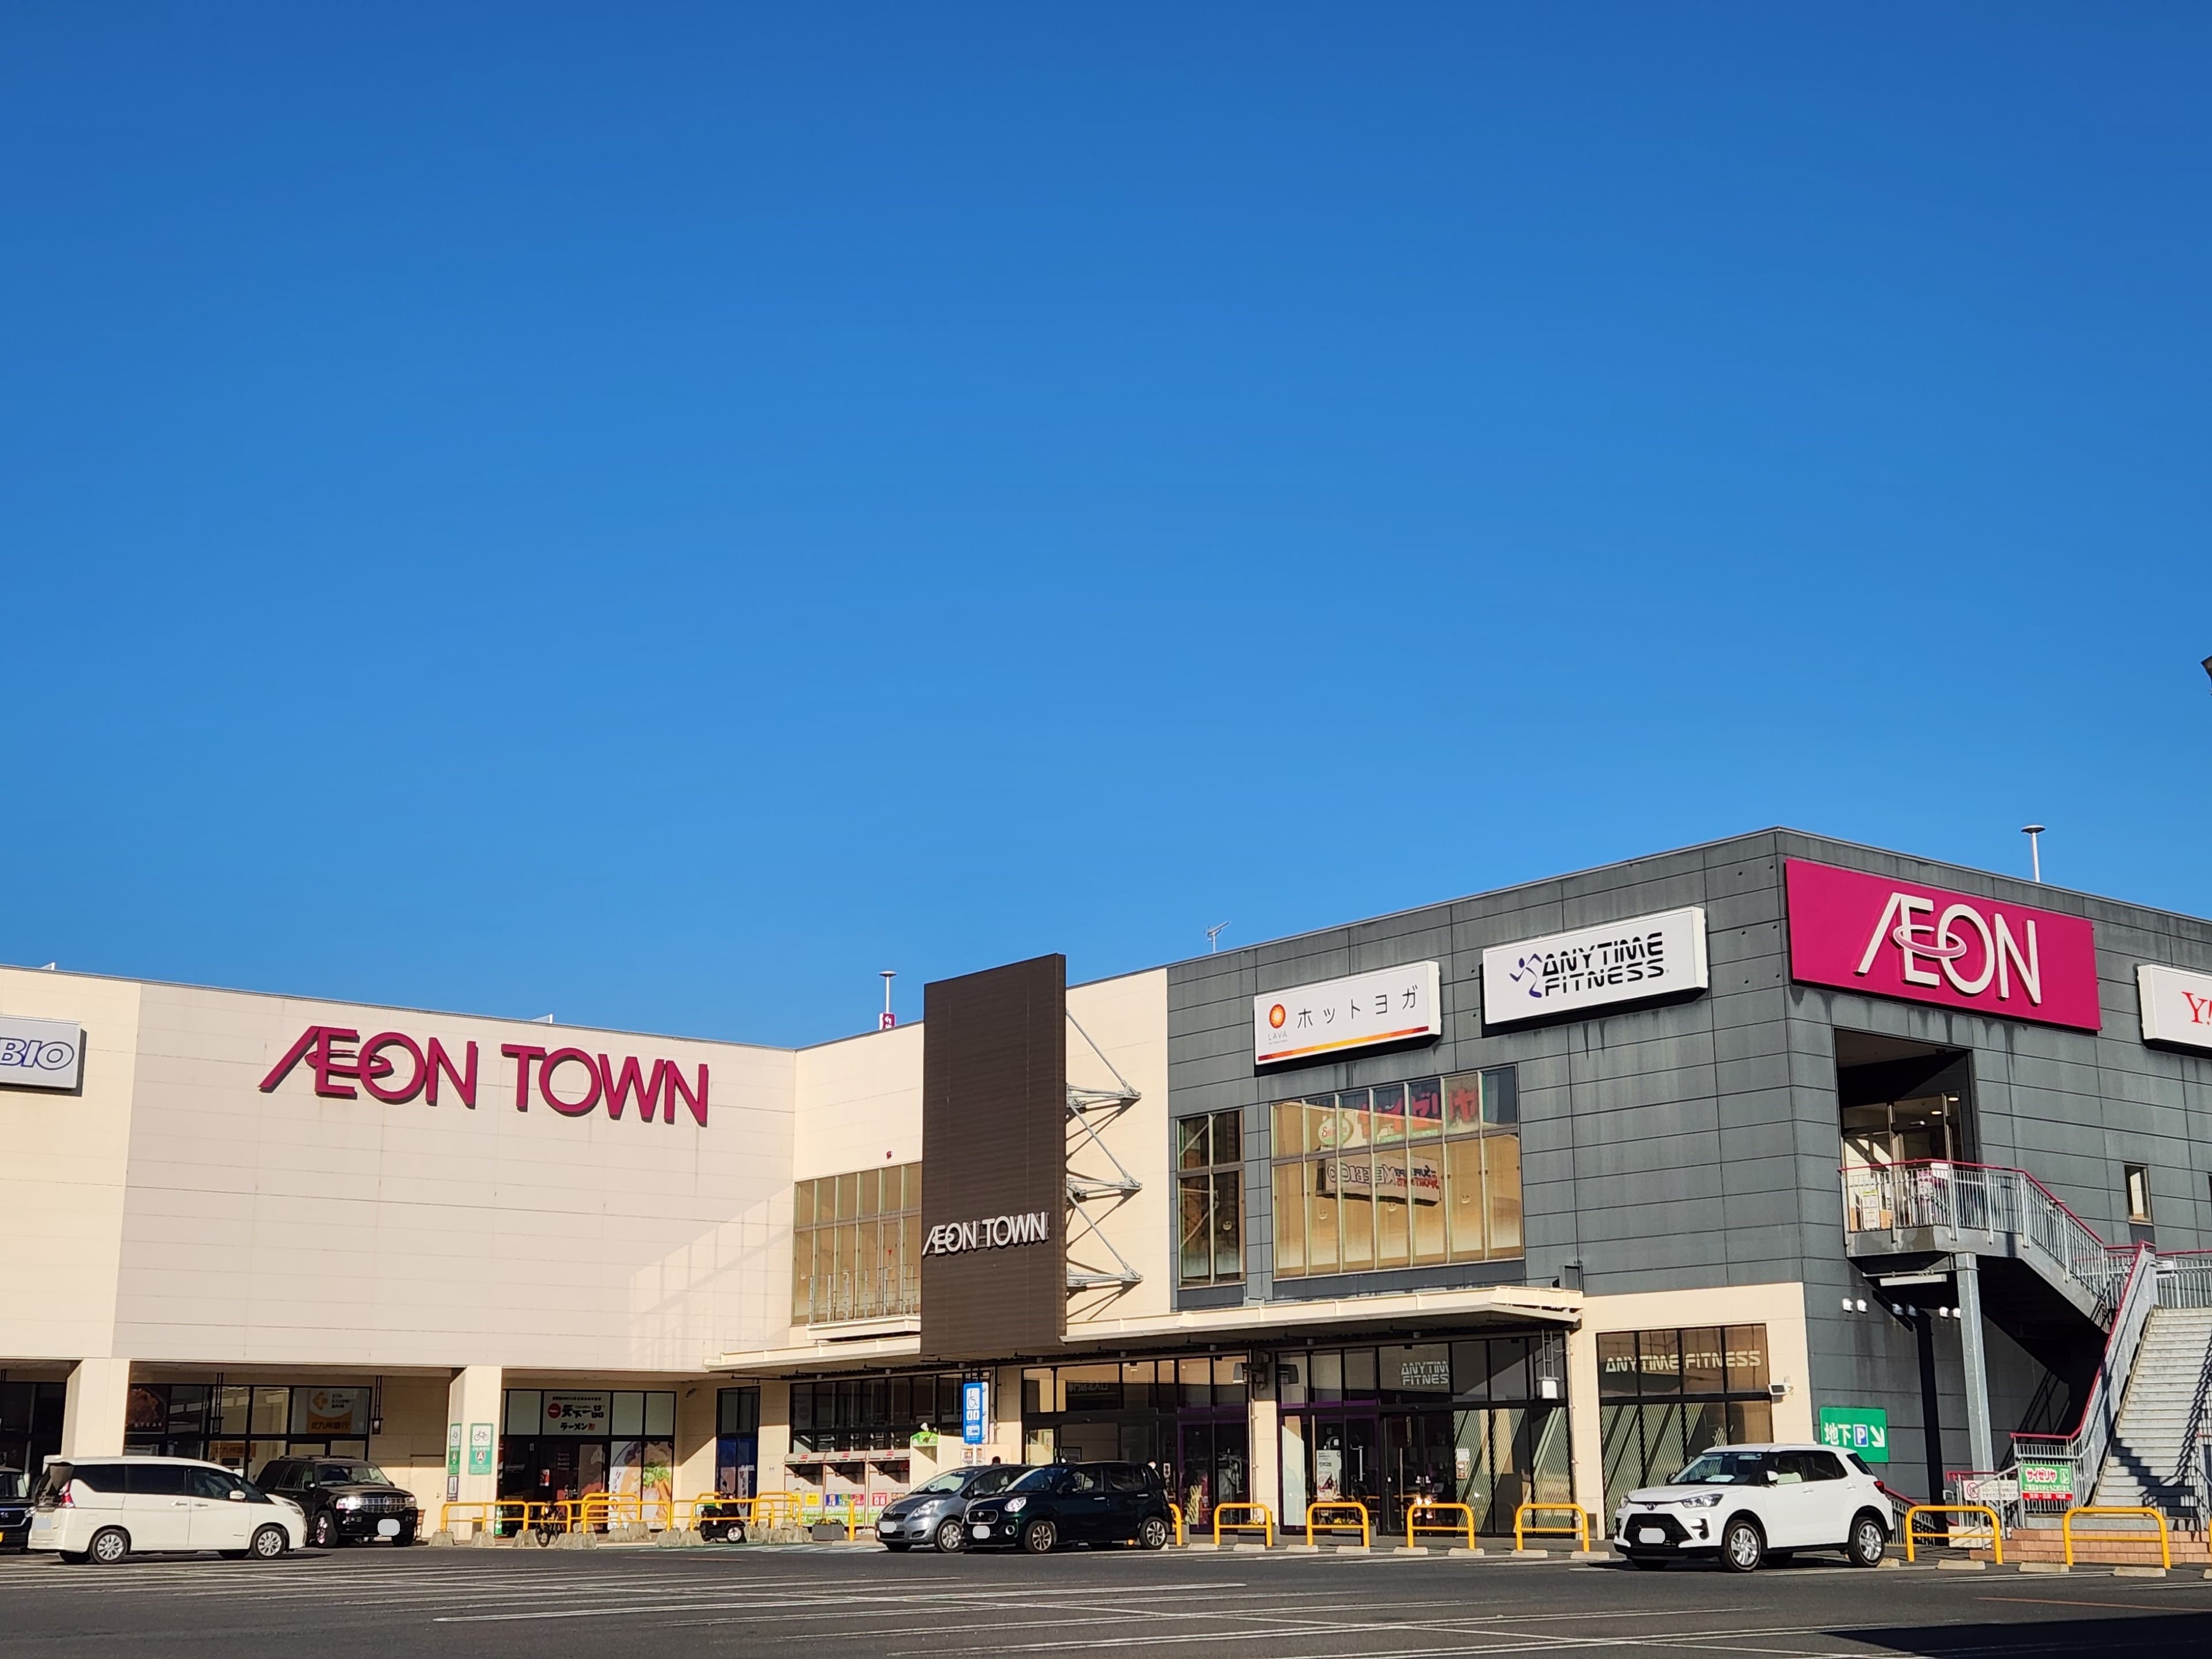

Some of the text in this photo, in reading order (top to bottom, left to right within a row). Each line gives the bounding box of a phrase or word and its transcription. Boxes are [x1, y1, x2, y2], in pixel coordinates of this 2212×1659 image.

[1542, 932, 1663, 977] ANYTIME
[1545, 957, 1664, 997] FITNESS
[1297, 984, 1418, 1029] ホットヨガ
[501, 1043, 709, 1126] TOWN
[982, 1211, 1046, 1247] TOWN
[1605, 1350, 1762, 1373] ANYTIME FITNESS
[561, 1404, 604, 1418] 天下一品
[560, 1422, 588, 1431] ラーメン
[1824, 1422, 1851, 1446] 地下
[2026, 1468, 2056, 1482] サイゼリヤ
